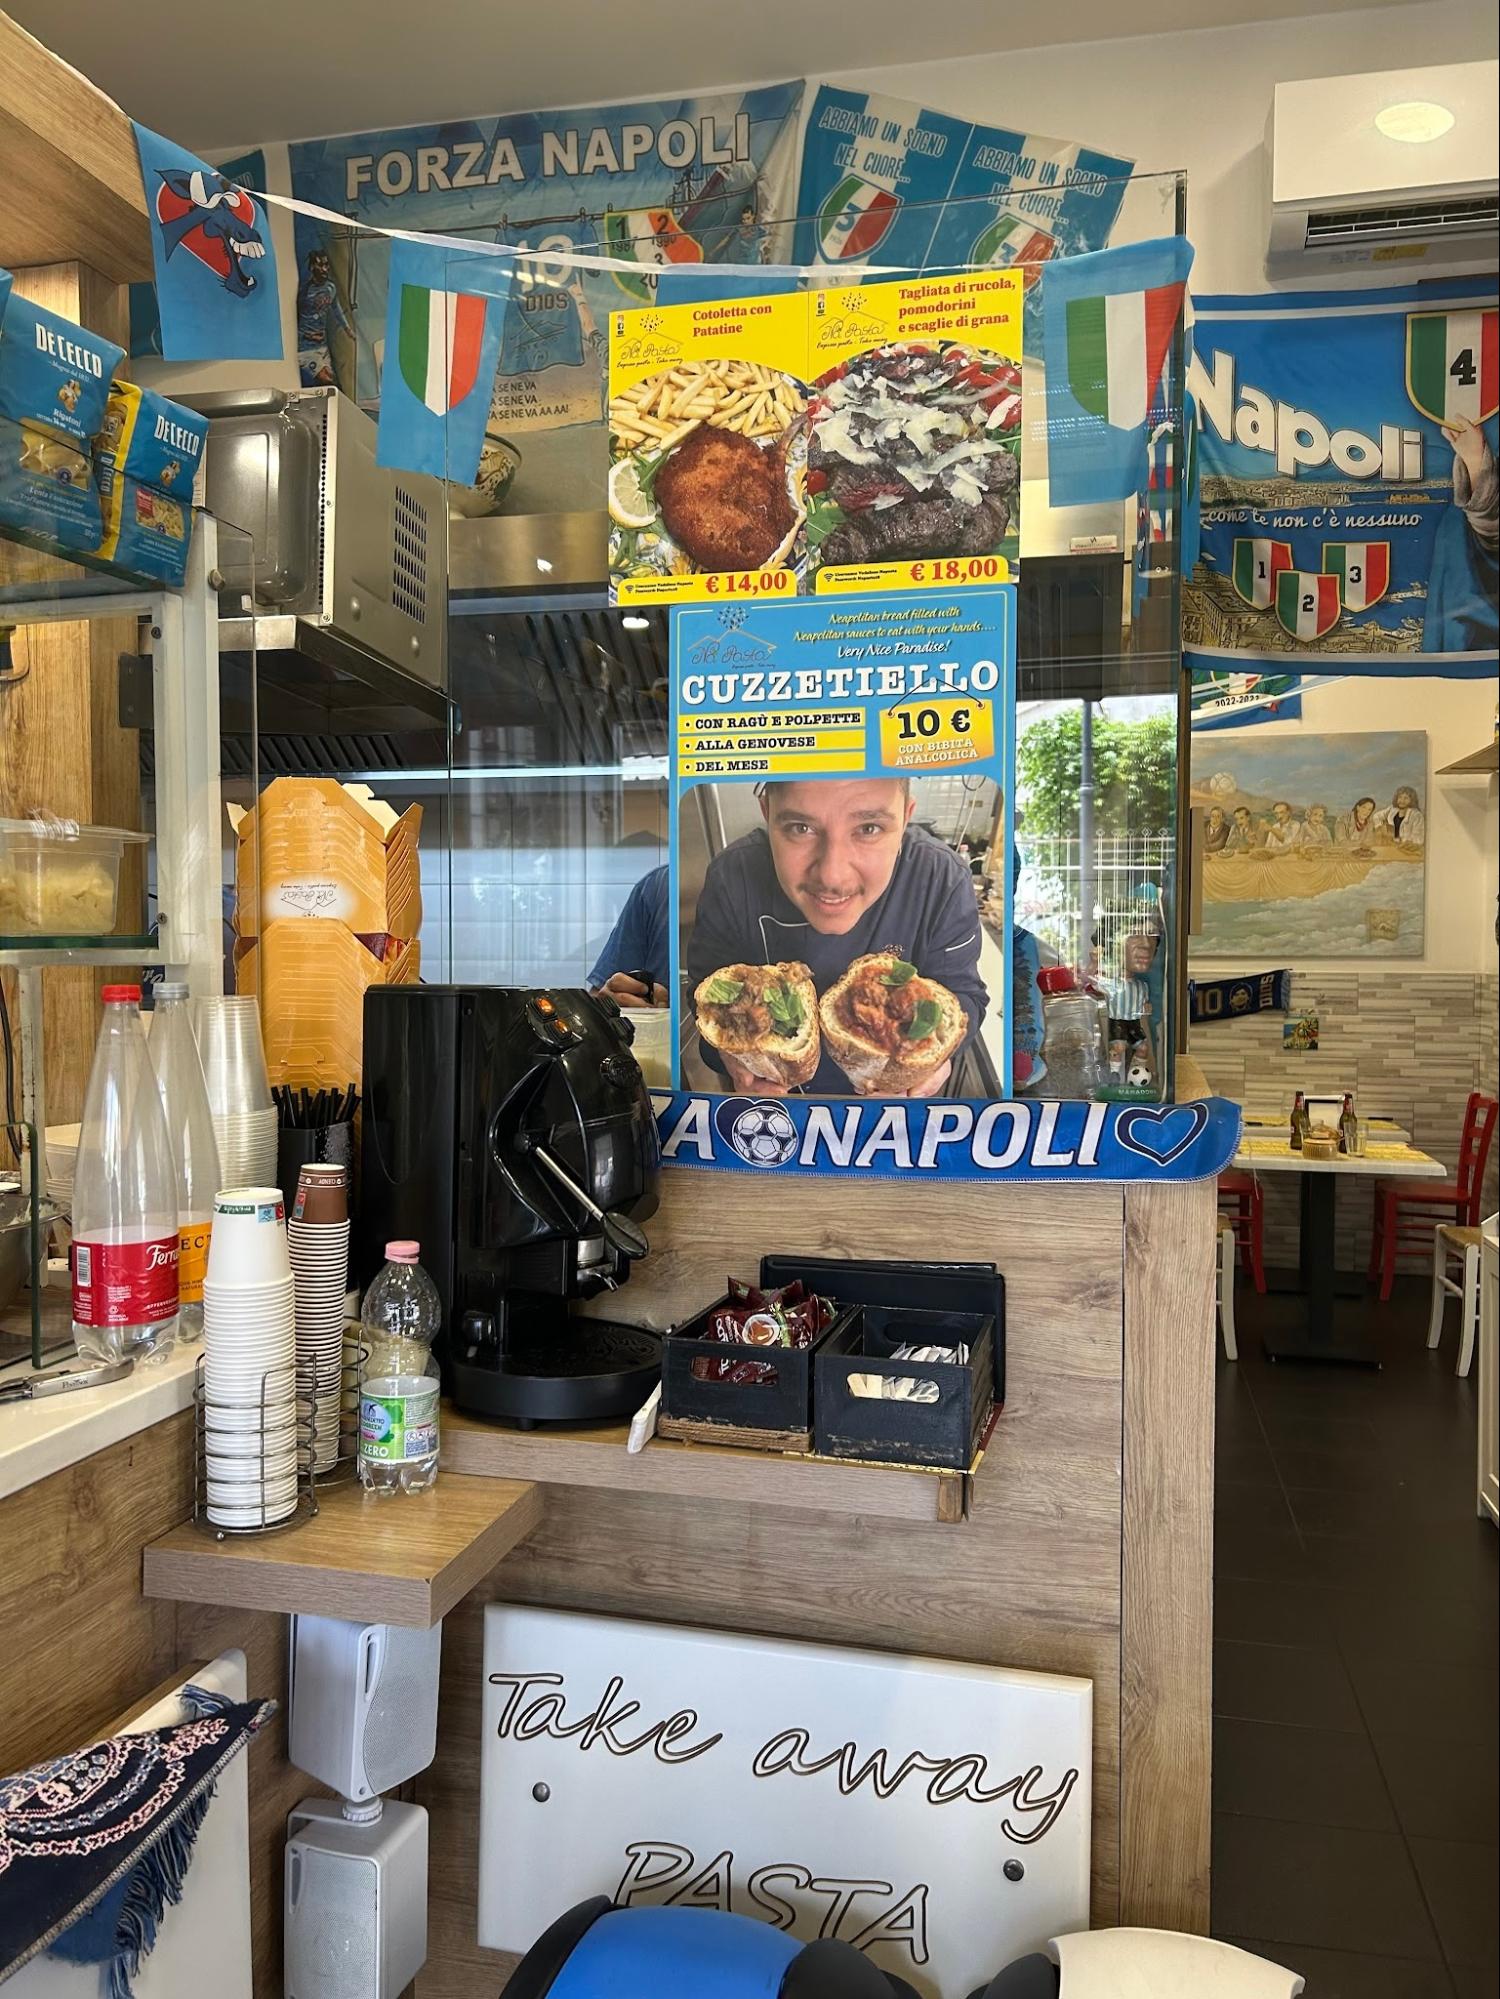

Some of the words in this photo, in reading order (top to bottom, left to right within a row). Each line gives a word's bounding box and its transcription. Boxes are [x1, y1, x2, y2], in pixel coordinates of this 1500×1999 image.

[818, 106, 879, 139] ABBIAMO
[881, 121, 902, 145] UN
[903, 127, 948, 158] SOGNO
[345, 137, 525, 200] FORZA
[542, 112, 750, 178] NAPOLI
[833, 144, 857, 168] NEL
[863, 151, 911, 183] CUORE...
[972, 145, 1036, 180] ABBIAMO
[1038, 161, 1060, 186] UN
[1062, 168, 1108, 198] SOGNO
[988, 182, 1014, 207] NEL
[1019, 191, 1070, 224] CUORE...
[615, 215, 627, 240] 1
[656, 214, 671, 236] 2
[834, 202, 863, 232] 3
[517, 234, 573, 292] 10
[899, 286, 950, 301] Tagliata
[953, 281, 967, 294] di
[970, 278, 1016, 293] rucola,
[692, 307, 747, 321] Cotoletta
[750, 305, 772, 315] con
[899, 298, 976, 319] pomodorini
[692, 323, 743, 337] Patatine
[899, 324, 906, 333] e
[908, 317, 953, 335] scaglie
[956, 314, 969, 327] di
[972, 314, 1010, 330] grana
[35, 322, 56, 356] DE
[57, 334, 102, 378] CECCO
[1450, 349, 1477, 386] 4
[1185, 348, 1424, 481] Napoli
[154, 414, 170, 442] DE
[170, 422, 200, 456] CECCO
[1208, 510, 1248, 524] come
[1252, 507, 1269, 525] te
[1273, 514, 1306, 529] non
[1312, 507, 1341, 528] c'è
[1345, 512, 1424, 528] nessuno
[910, 563, 925, 581] €
[931, 558, 998, 583] 18,00
[1257, 561, 1266, 579] 1
[1349, 565, 1362, 583] 3
[705, 575, 720, 593] €
[726, 572, 787, 595] 14,00
[1302, 594, 1315, 612] 2
[829, 613, 881, 626] Neapolitan
[882, 610, 909, 622] bread
[910, 608, 937, 624] filled
[938, 606, 960, 618] with
[793, 629, 844, 642] Neapolitan
[846, 628, 875, 639] sauces
[877, 627, 885, 637] to
[886, 626, 903, 637] eat
[903, 624, 926, 636] with
[926, 624, 950, 639] your
[838, 643, 864, 660] Very
[866, 641, 892, 656] Nice
[893, 639, 951, 655] Paradise!
[682, 660, 1000, 705] CUZZETIELLO
[695, 717, 725, 730] CON
[727, 713, 766, 729] RAGÙ
[772, 715, 781, 727] E
[785, 712, 861, 726] POLPETTE
[898, 709, 940, 739] 10
[951, 709, 970, 733] €
[695, 738, 734, 750] ALLA
[738, 736, 816, 749] GENOVESE
[898, 742, 925, 754] CON
[927, 738, 973, 751] BIBITA
[695, 759, 724, 772] DEL
[727, 759, 768, 771] MESE
[895, 749, 978, 767] ANALCOLICA
[1196, 988, 1222, 1015] 10
[799, 1100, 1109, 1169] NAPOLI
[364, 1444, 389, 1457] ZERO
[489, 1673, 723, 1765] Take
[752, 1727, 1079, 1845] away
[614, 1841, 930, 1965] PASTA
